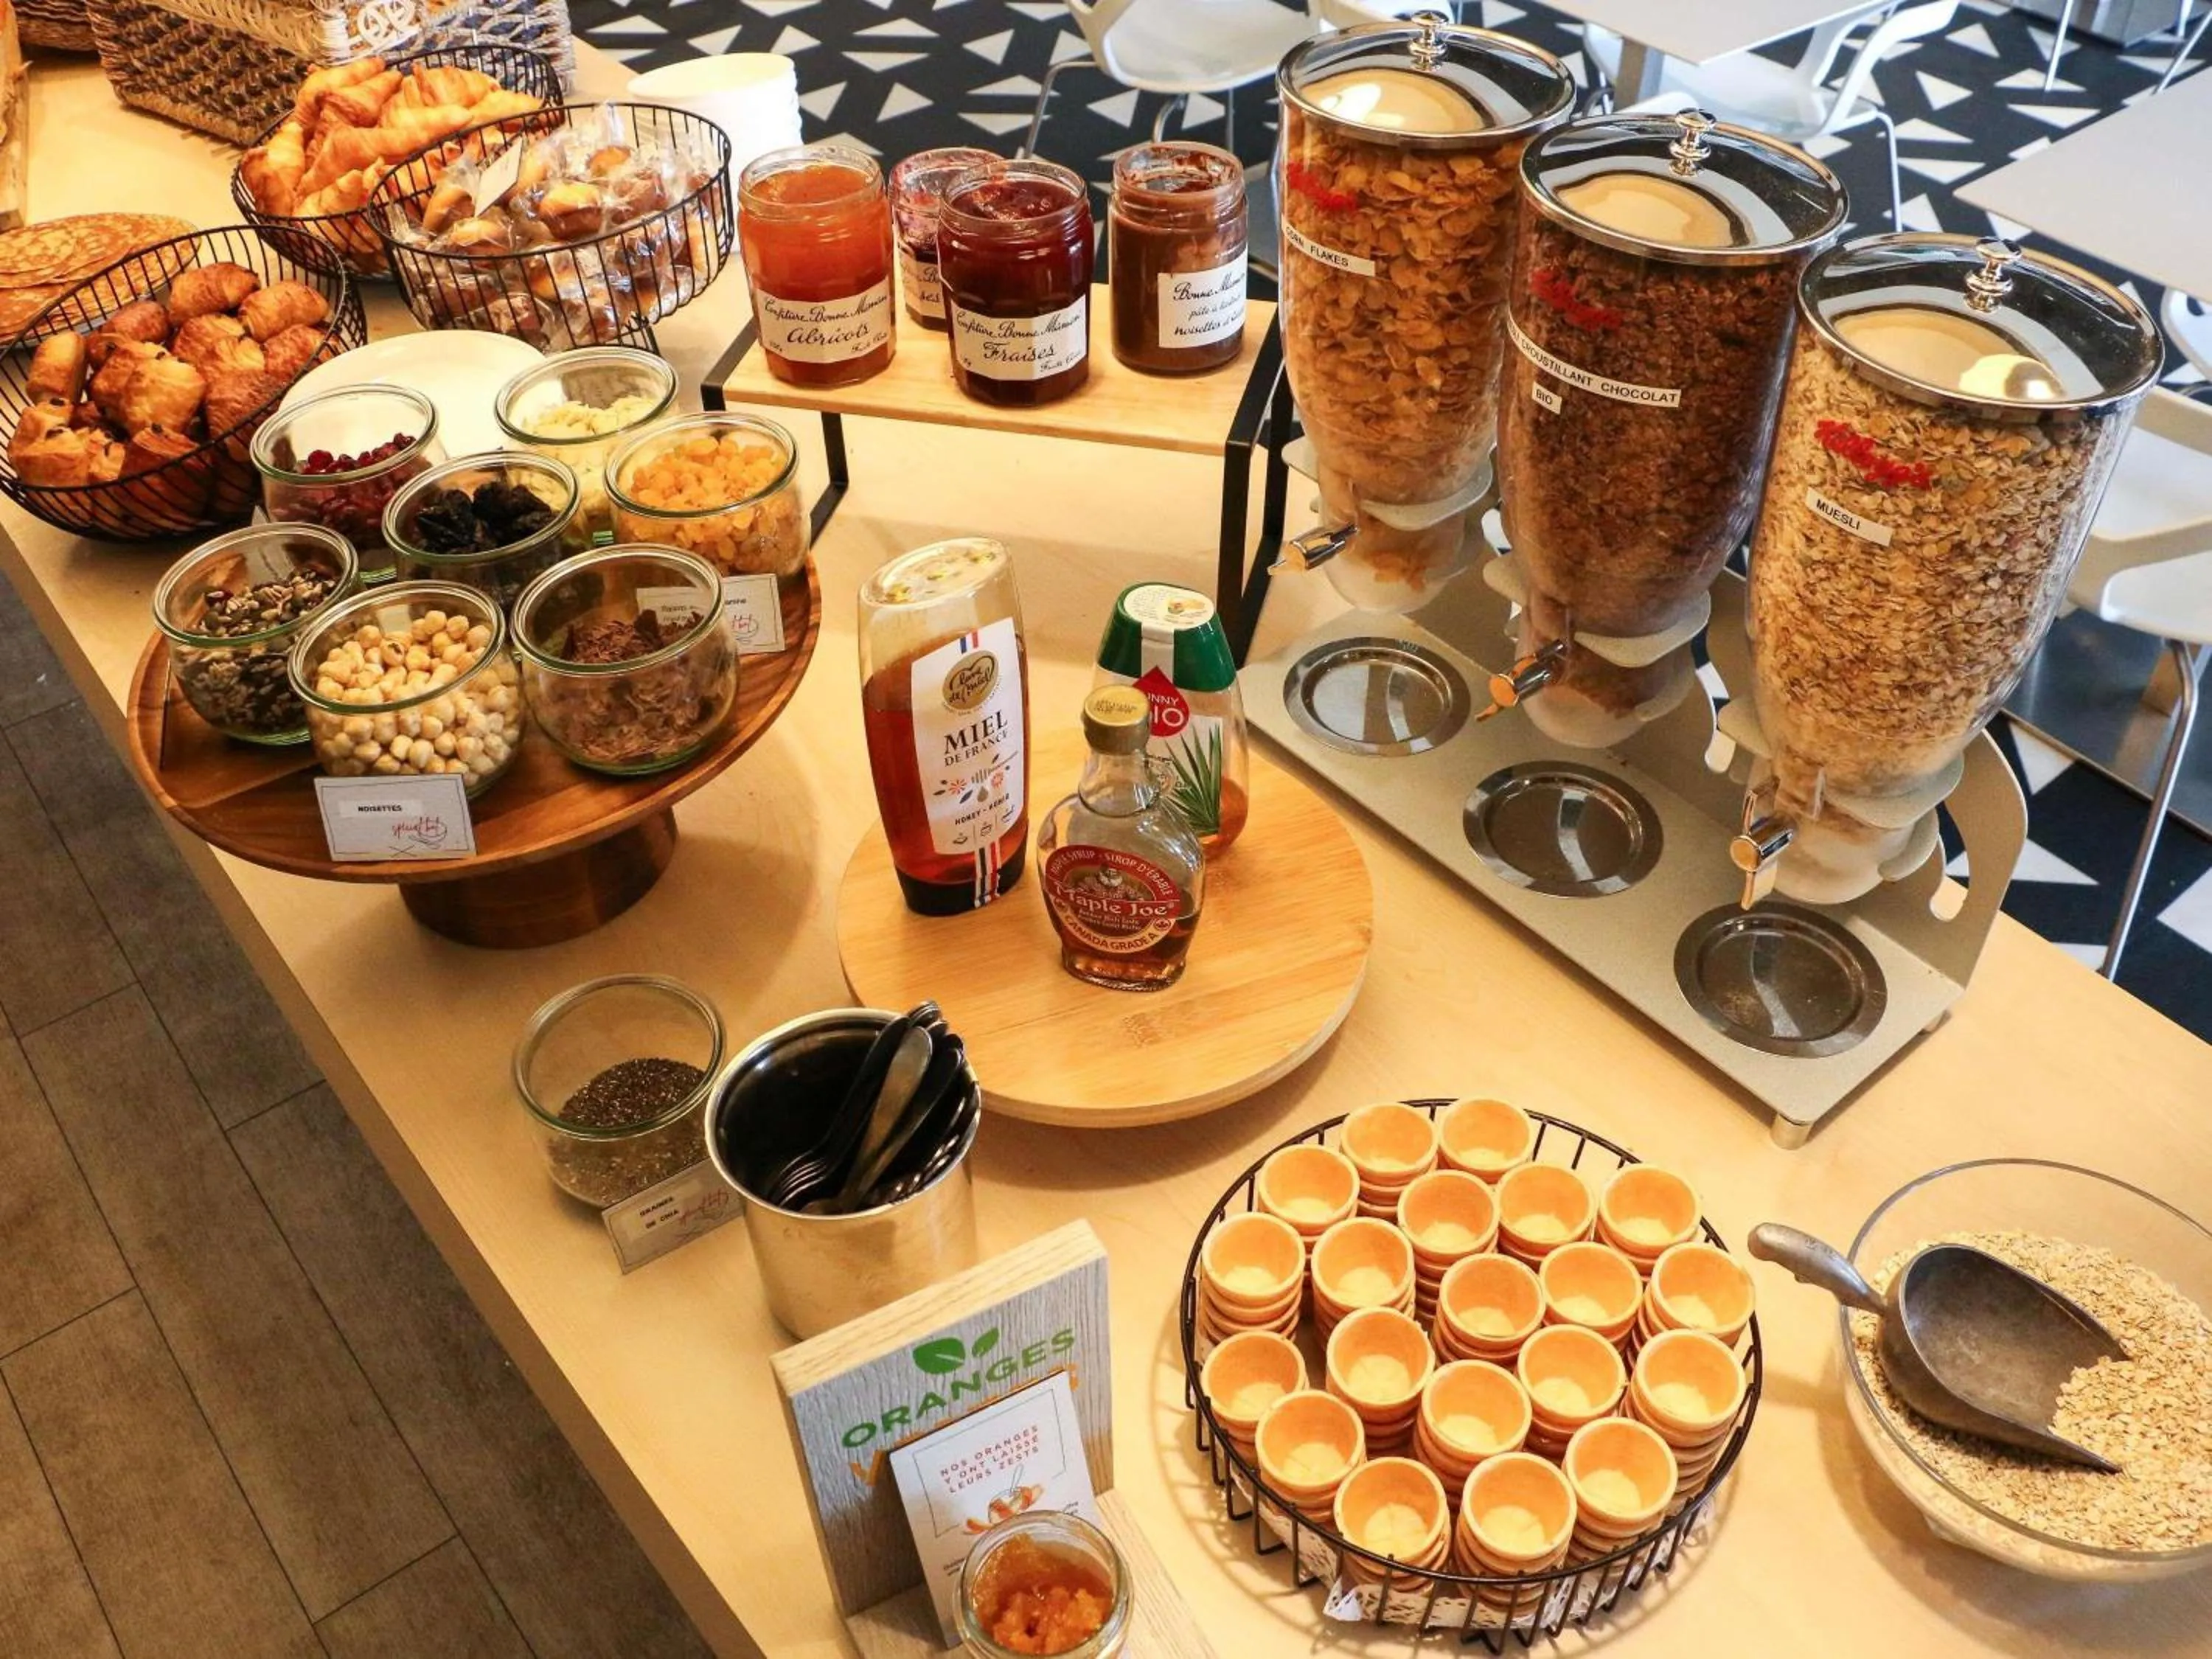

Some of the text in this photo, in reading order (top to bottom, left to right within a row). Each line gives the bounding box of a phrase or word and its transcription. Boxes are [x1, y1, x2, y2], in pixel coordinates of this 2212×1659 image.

[1310, 245, 1349, 267] FLAKES
[998, 321, 1040, 338] Bonne
[1174, 321, 1221, 336] noisettes
[983, 342, 1055, 362] Fraises
[1522, 340, 1677, 403] CROUSTILLANT CHOCOLAT
[1536, 389, 1553, 405] BIO
[1816, 498, 1860, 530] MUESLI
[944, 709, 1008, 754] MIEL
[945, 730, 1008, 767] DE FRANCE
[358, 804, 403, 813] NOISETTES
[955, 811, 981, 825] HONEY
[1105, 853, 1136, 866] SIROP
[1054, 882, 1168, 916] Maple Joe
[1065, 916, 1109, 947] CANADA
[1110, 936, 1149, 950] GRADE
[842, 1328, 1075, 1448] ORANGES
[940, 1425, 1038, 1476] NOS ORANGES
[959, 1461, 985, 1479] ONT
[992, 1435, 1039, 1463] LAISSE
[949, 1446, 1039, 1494] LEURS ZESTS
